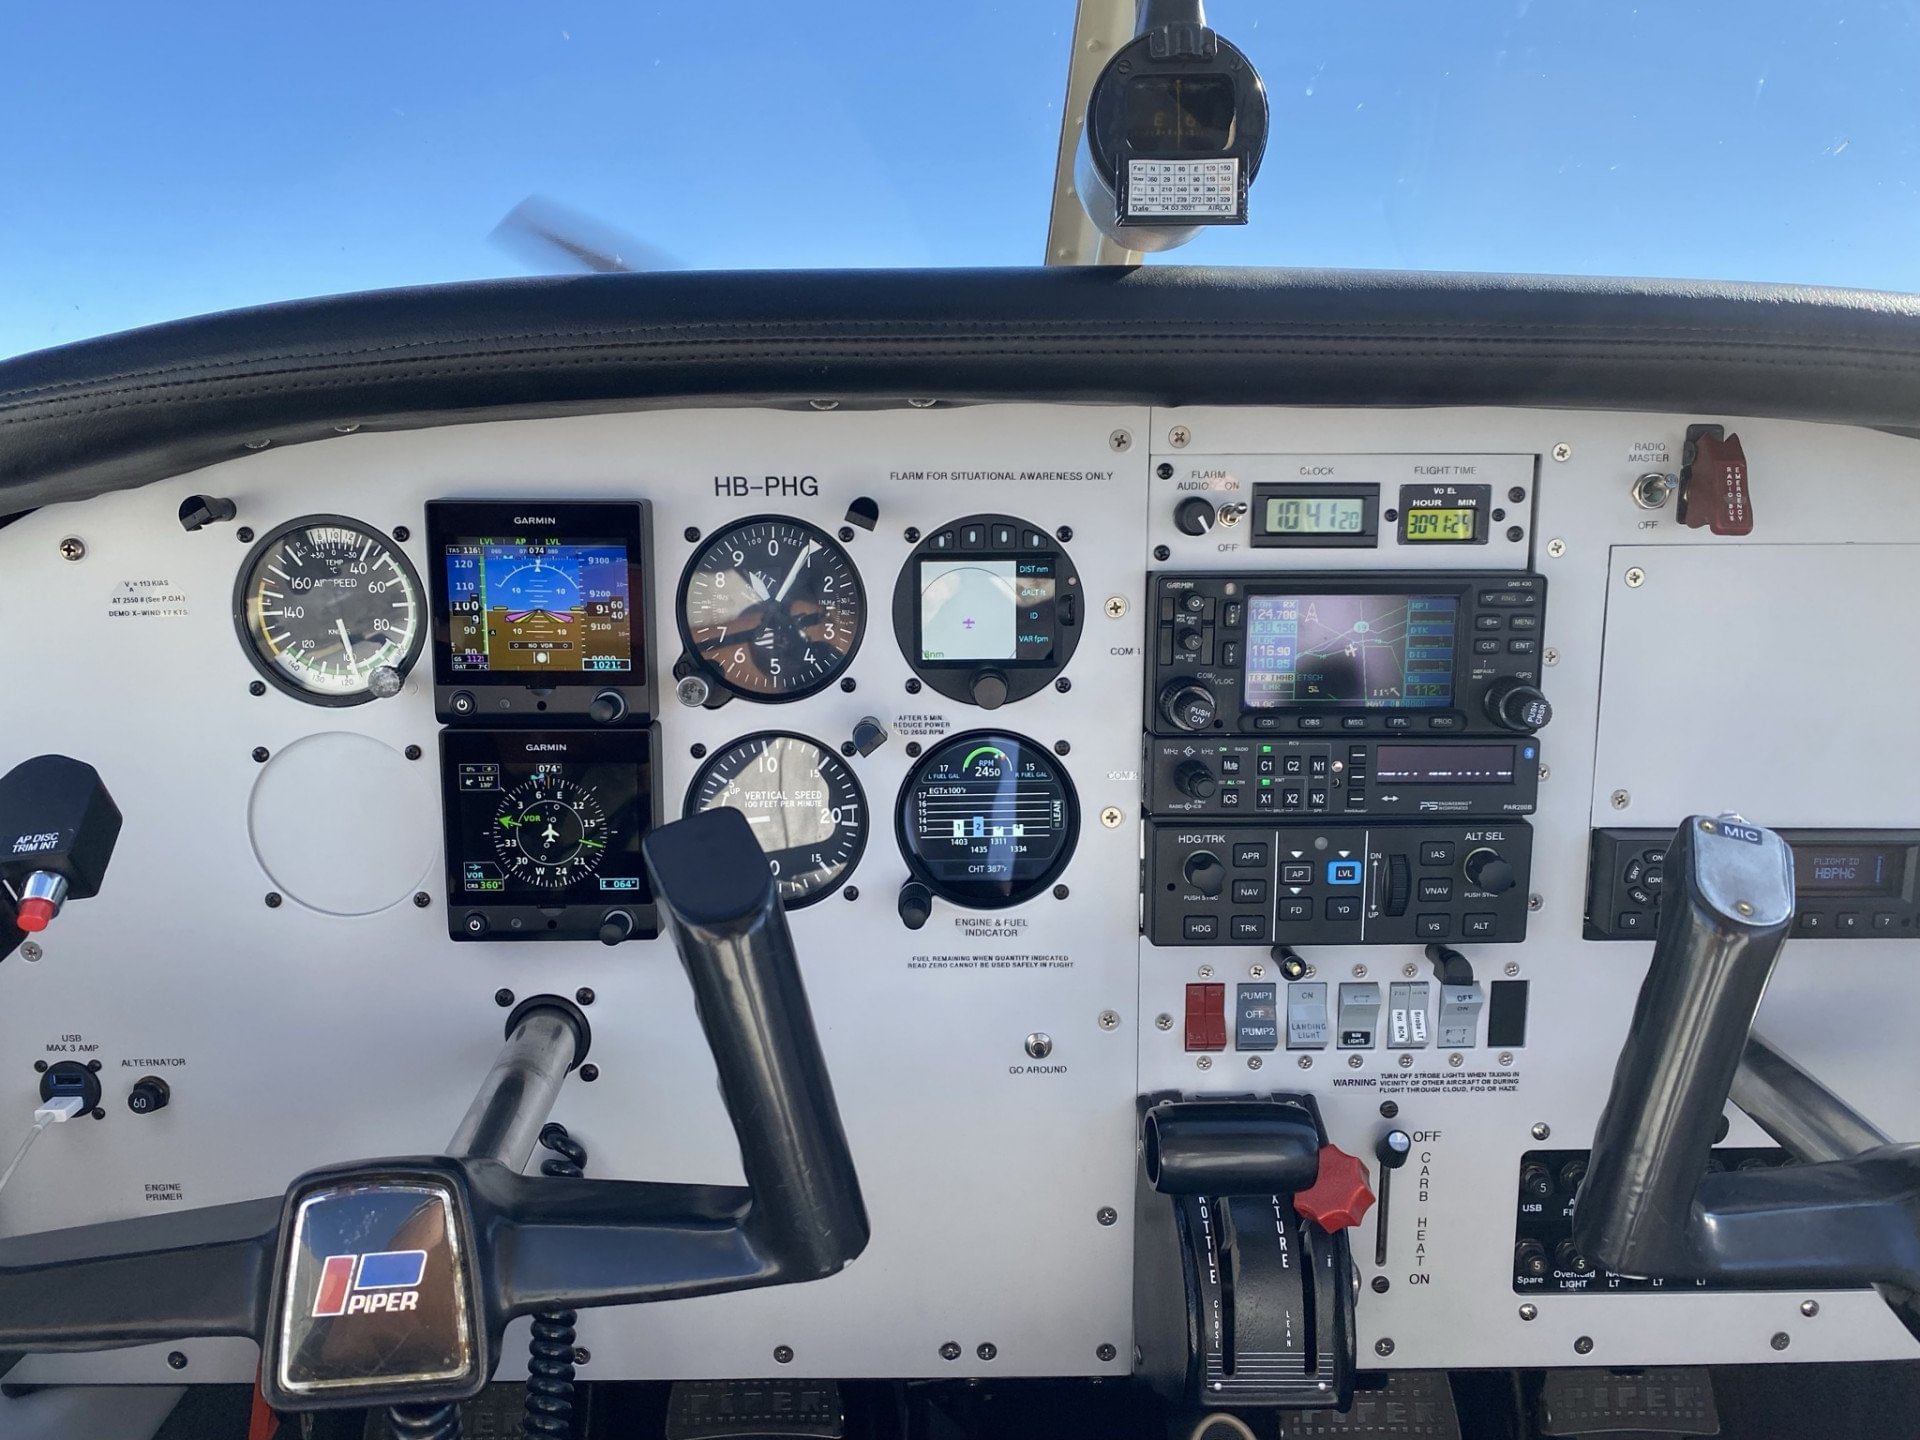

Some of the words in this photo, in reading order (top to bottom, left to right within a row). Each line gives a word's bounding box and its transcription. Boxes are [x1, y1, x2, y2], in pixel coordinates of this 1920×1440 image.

[1191, 470, 1226, 479] FLARM
[1300, 467, 1334, 475] CLOCK
[1414, 466, 1449, 475] FLIGHT
[1453, 466, 1476, 475] TIME
[891, 472, 923, 480] FLARM
[927, 472, 947, 480] FOR
[950, 472, 1016, 480] SITUATIONAL
[1020, 472, 1082, 480] AWARENESS
[1086, 472, 1113, 480] ONLY
[715, 477, 818, 497] HB-PHG
[1177, 482, 1208, 490] AUDIO
[1225, 482, 1239, 490] ON
[784, 538, 802, 546] FEET
[1218, 543, 1238, 552] OFF
[351, 563, 367, 574] 40
[291, 577, 311, 589] 160
[368, 582, 385, 593] 60
[284, 607, 304, 618] 140
[373, 619, 389, 630] 80
[302, 640, 315, 648] 120
[804, 649, 816, 663] 4
[1191, 707, 1211, 717] PUSH
[1528, 703, 1538, 722] PUSH
[1192, 715, 1205, 724] C/V
[759, 758, 777, 772] 10
[1224, 761, 1238, 770] Mute
[1261, 761, 1272, 770] C1
[1288, 762, 1299, 771] C2
[1314, 762, 1325, 770] N1
[975, 767, 1000, 776] 2450
[745, 791, 787, 800] VERTICAL
[795, 791, 822, 799] SPEED
[1261, 795, 1271, 803] X1
[1287, 794, 1298, 803] X2
[1313, 794, 1324, 803] N2
[1053, 801, 1061, 822] LEAN
[821, 809, 842, 824] 20
[16, 836, 32, 844] AP
[33, 832, 59, 842] DISC
[1465, 832, 1483, 840] ALT
[1486, 832, 1505, 840] SEL
[1725, 826, 1758, 841] MIC
[1179, 835, 1225, 843] HDG/TRK
[13, 843, 38, 853] TRIM
[40, 841, 58, 850] INT
[811, 854, 822, 862] 15
[1815, 868, 1856, 879] HBPHG
[1635, 892, 1647, 901] OFF
[956, 919, 991, 927] ENGINE
[995, 919, 1001, 927] &
[1004, 918, 1028, 926] FUEL
[966, 929, 1018, 937] INDICATOR
[1242, 1028, 1275, 1036] PUMP2
[78, 1044, 98, 1052] AMP
[122, 1058, 186, 1067] ALTERNATOR
[134, 1099, 146, 1108] 60
[1413, 1131, 1441, 1142] OFF
[1419, 1152, 1431, 1202] CARB
[146, 1193, 182, 1201] PRIMER
[1416, 1217, 1427, 1266] HEAT
[1409, 1274, 1430, 1285] ON
[1517, 1276, 1543, 1285] Spare
[1560, 1280, 1588, 1288] LIGHT
[348, 1291, 419, 1314] PIPER
